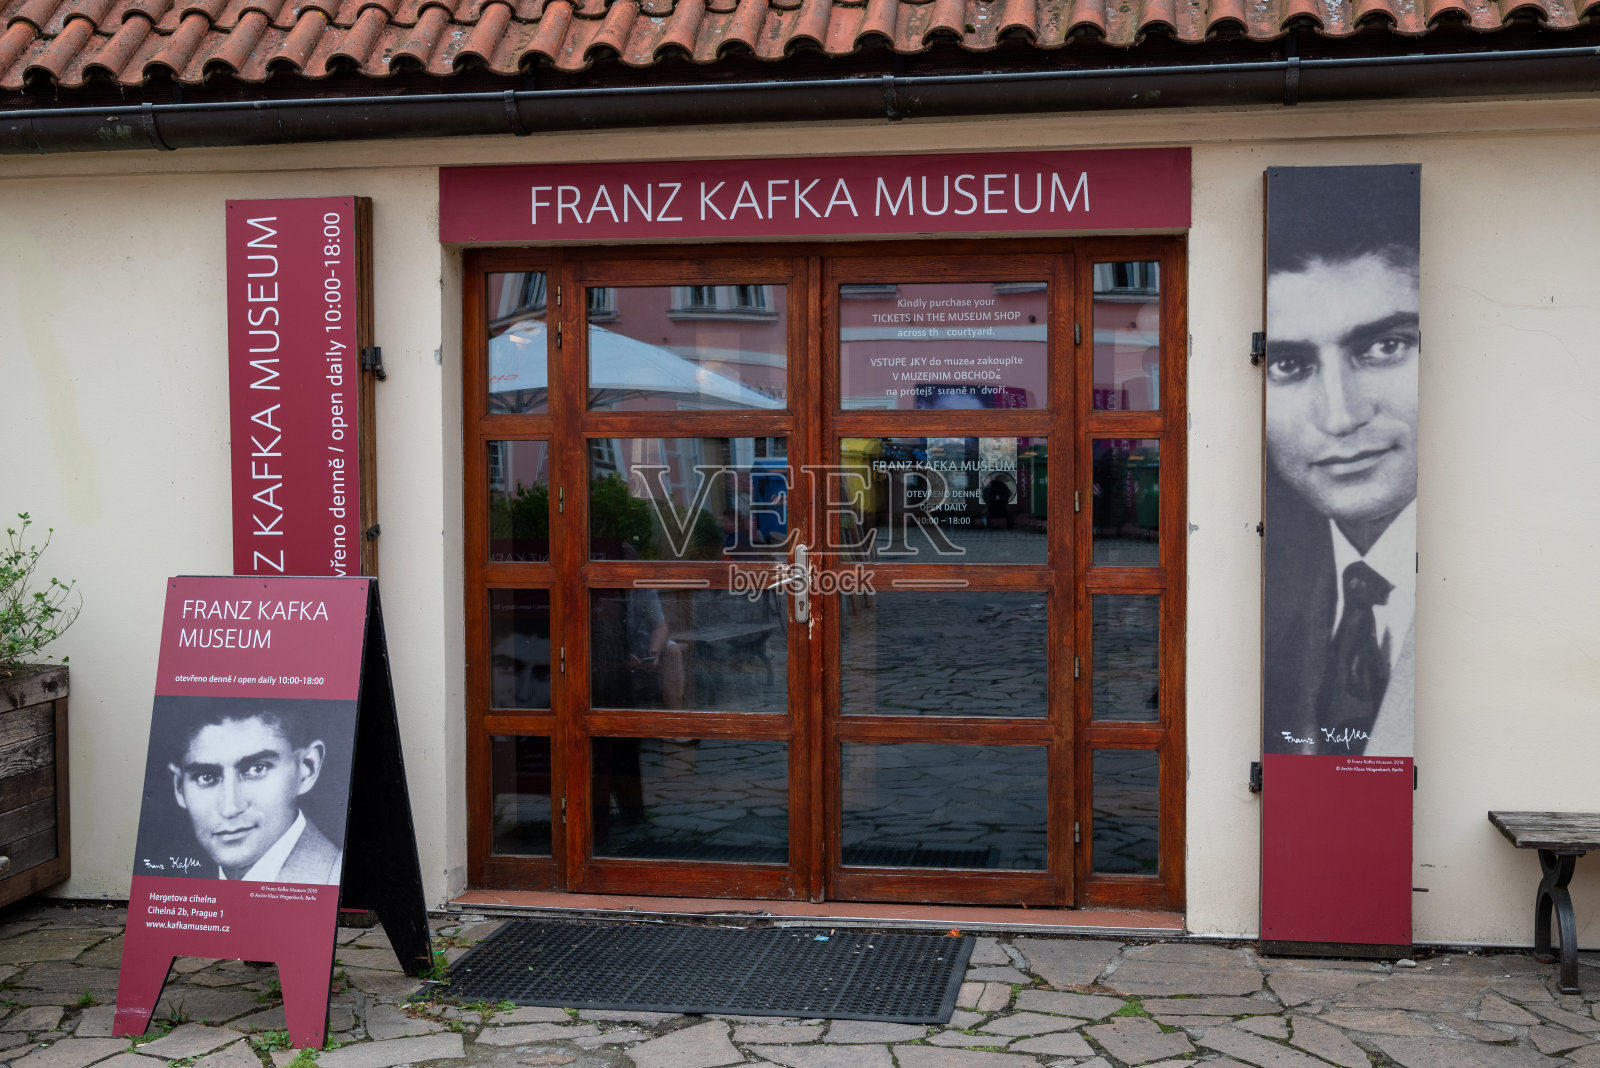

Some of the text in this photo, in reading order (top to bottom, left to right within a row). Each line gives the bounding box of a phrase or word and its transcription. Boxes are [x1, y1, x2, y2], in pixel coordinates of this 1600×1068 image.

[530, 172, 1090, 225] FRANZ KAFKA MUSEUM
[323, 212, 342, 332] 10:00-18:00
[247, 216, 280, 390] MUSEUM
[897, 298, 995, 309] Kindly purchase your
[872, 311, 1021, 323] TICKETS IN THE MUSEUM SHOP
[897, 327, 995, 338] across th courtyard.
[325, 339, 346, 386] daily
[929, 357, 941, 366] do
[977, 356, 1023, 365] zakoupíte
[892, 373, 899, 381] V
[330, 392, 348, 440] open
[251, 403, 283, 535] KAFKA
[872, 460, 1015, 471] FRANZ KAFKA MUSEUM
[328, 458, 346, 518] denně
[920, 503, 968, 511] OPEN DAILY
[917, 517, 939, 525] 10:00
[948, 517, 971, 525] 18:00
[182, 600, 328, 621] FRANZ KAFKA
[179, 628, 271, 649] MUSEUM
[175, 674, 207, 683] otevřeno
[209, 675, 232, 683] denně
[238, 677, 256, 685] open
[258, 676, 276, 686] daily
[278, 676, 324, 685] 10:00-18:00
[1281, 727, 1371, 750] Franz Kafka
[143, 857, 202, 874] Franz Kafka
[149, 892, 217, 904] Hergetova cihelna
[147, 906, 224, 919] Cihelná 2b, Prague 1
[146, 920, 230, 933] www.kafkamuseum.cz
